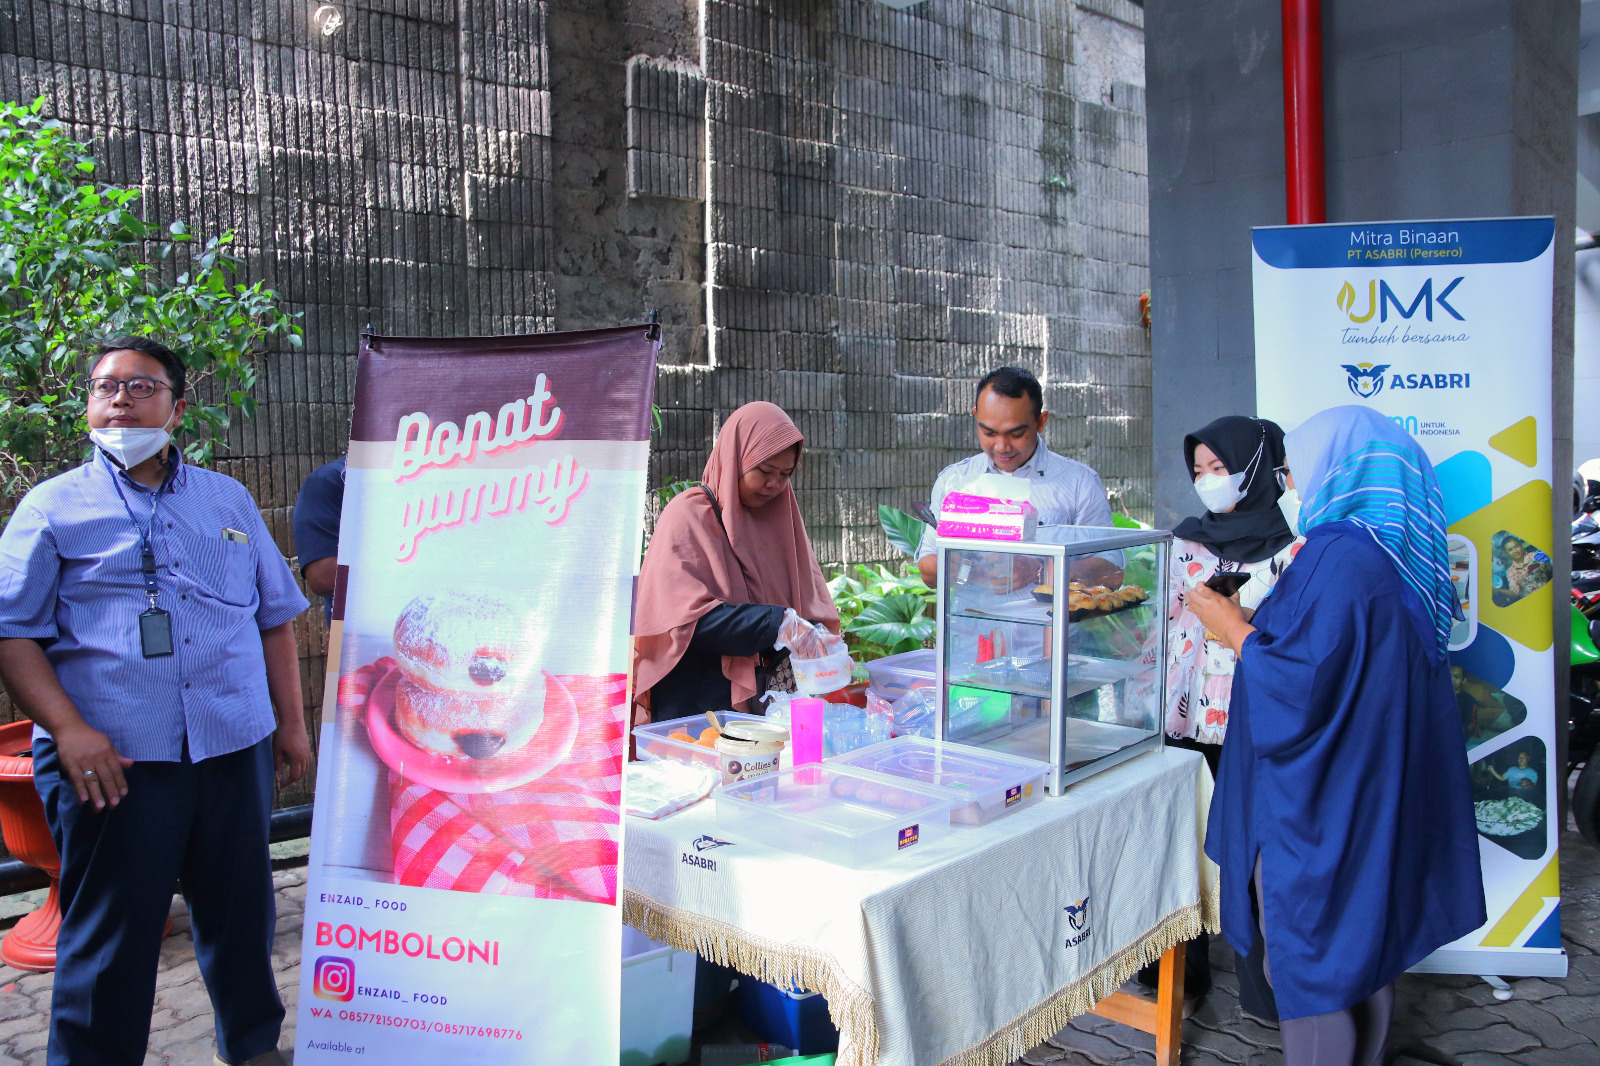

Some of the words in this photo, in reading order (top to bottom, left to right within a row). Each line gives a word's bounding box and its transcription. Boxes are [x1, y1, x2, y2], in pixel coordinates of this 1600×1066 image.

[1350, 230, 1392, 246] Mitra
[1399, 229, 1459, 245] Binaan
[1347, 250, 1362, 260] PT
[1365, 248, 1407, 260] ASABRI
[1410, 246, 1463, 259] (Persero)
[1336, 276, 1467, 324] UMK
[1401, 325, 1470, 345] bersama
[1389, 373, 1470, 390] ASABRI
[393, 372, 566, 484] Donat
[395, 455, 591, 564] yummy
[744, 761, 772, 772] Collins
[681, 852, 717, 872] ASABRI
[375, 899, 407, 912] FOOD
[315, 921, 500, 966] BOMBOLONI
[1065, 926, 1091, 949] ASABRI
[413, 992, 448, 1006] FOOD
[310, 1007, 333, 1020] WA
[338, 1010, 523, 1041] 085772150703/085717698776
[307, 1039, 353, 1054] Available
[354, 1045, 366, 1055] at
